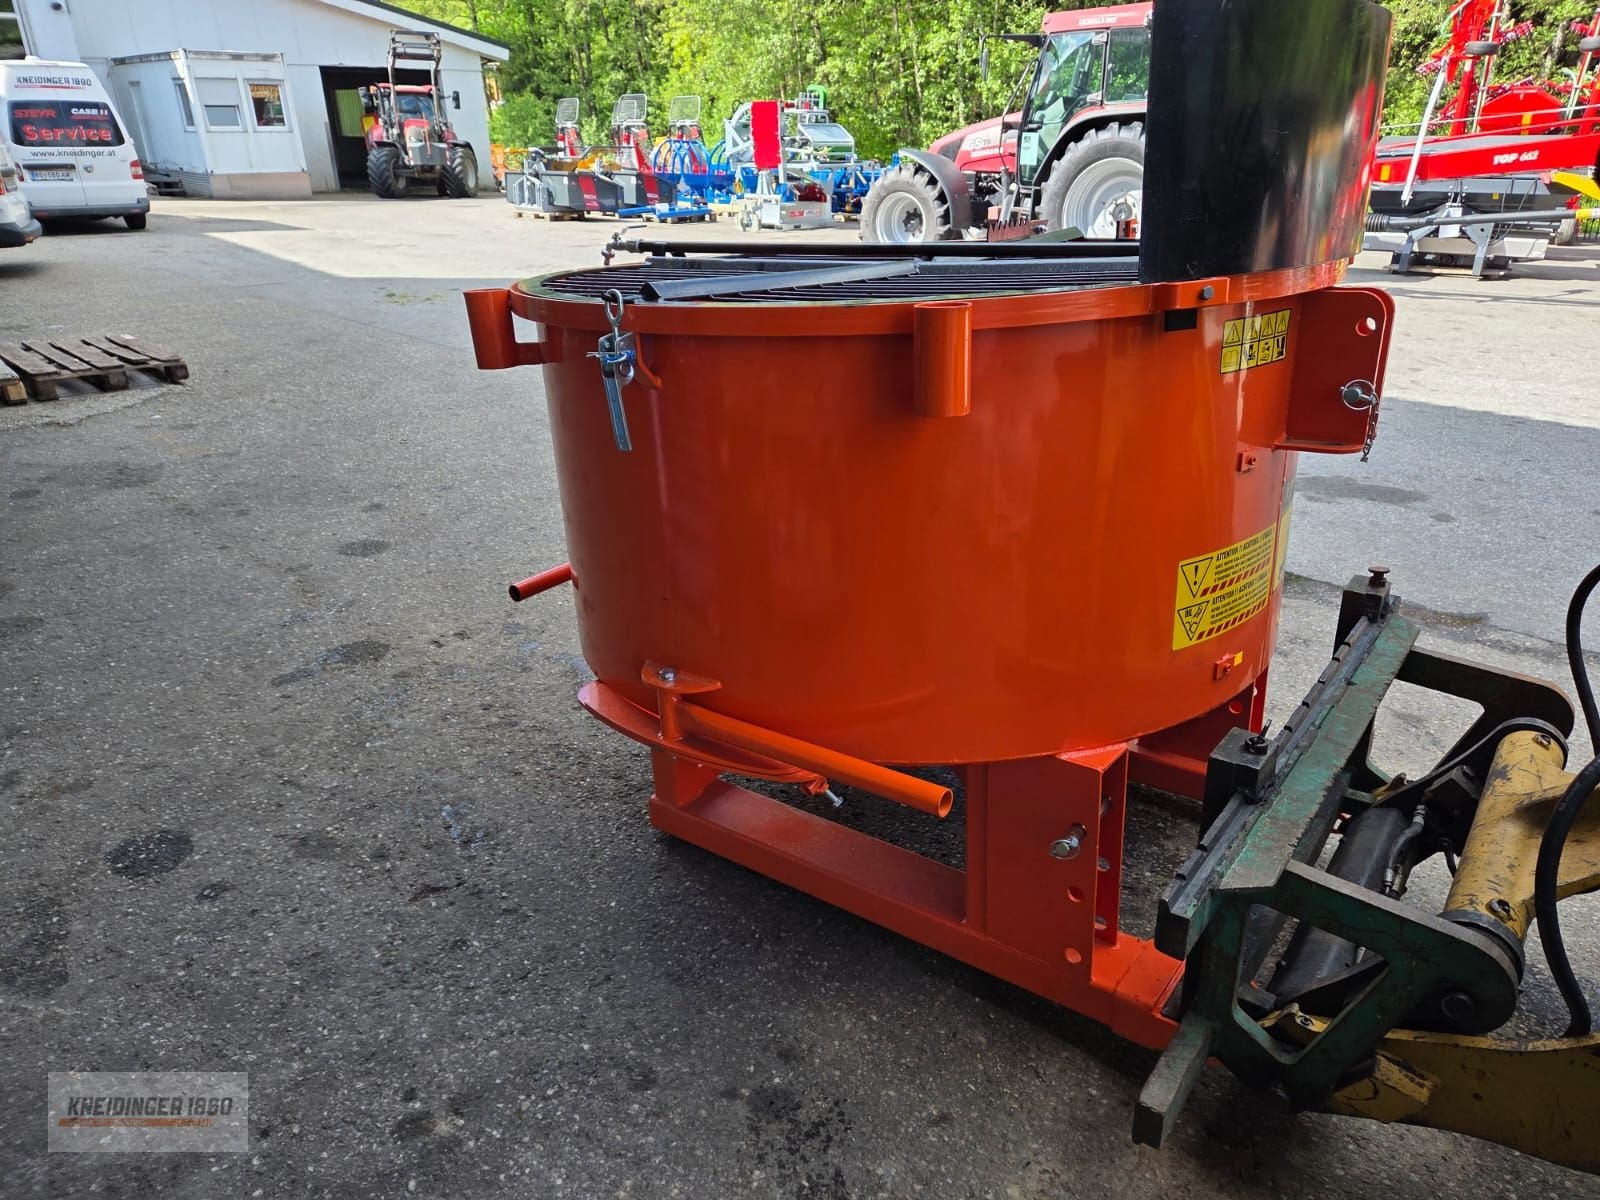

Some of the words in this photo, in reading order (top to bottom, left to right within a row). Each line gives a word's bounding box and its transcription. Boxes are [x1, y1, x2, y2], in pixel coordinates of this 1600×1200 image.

[16, 76, 70, 85] KNEIDINGER
[15, 109, 56, 118] STEYR
[23, 125, 112, 140] Service
[30, 149, 116, 158] www.kneidinger.at
[1493, 153, 1518, 165] TOP
[1519, 150, 1539, 161] 662
[1216, 546, 1239, 561] ATTENTION
[1212, 590, 1235, 605] ATTENTION
